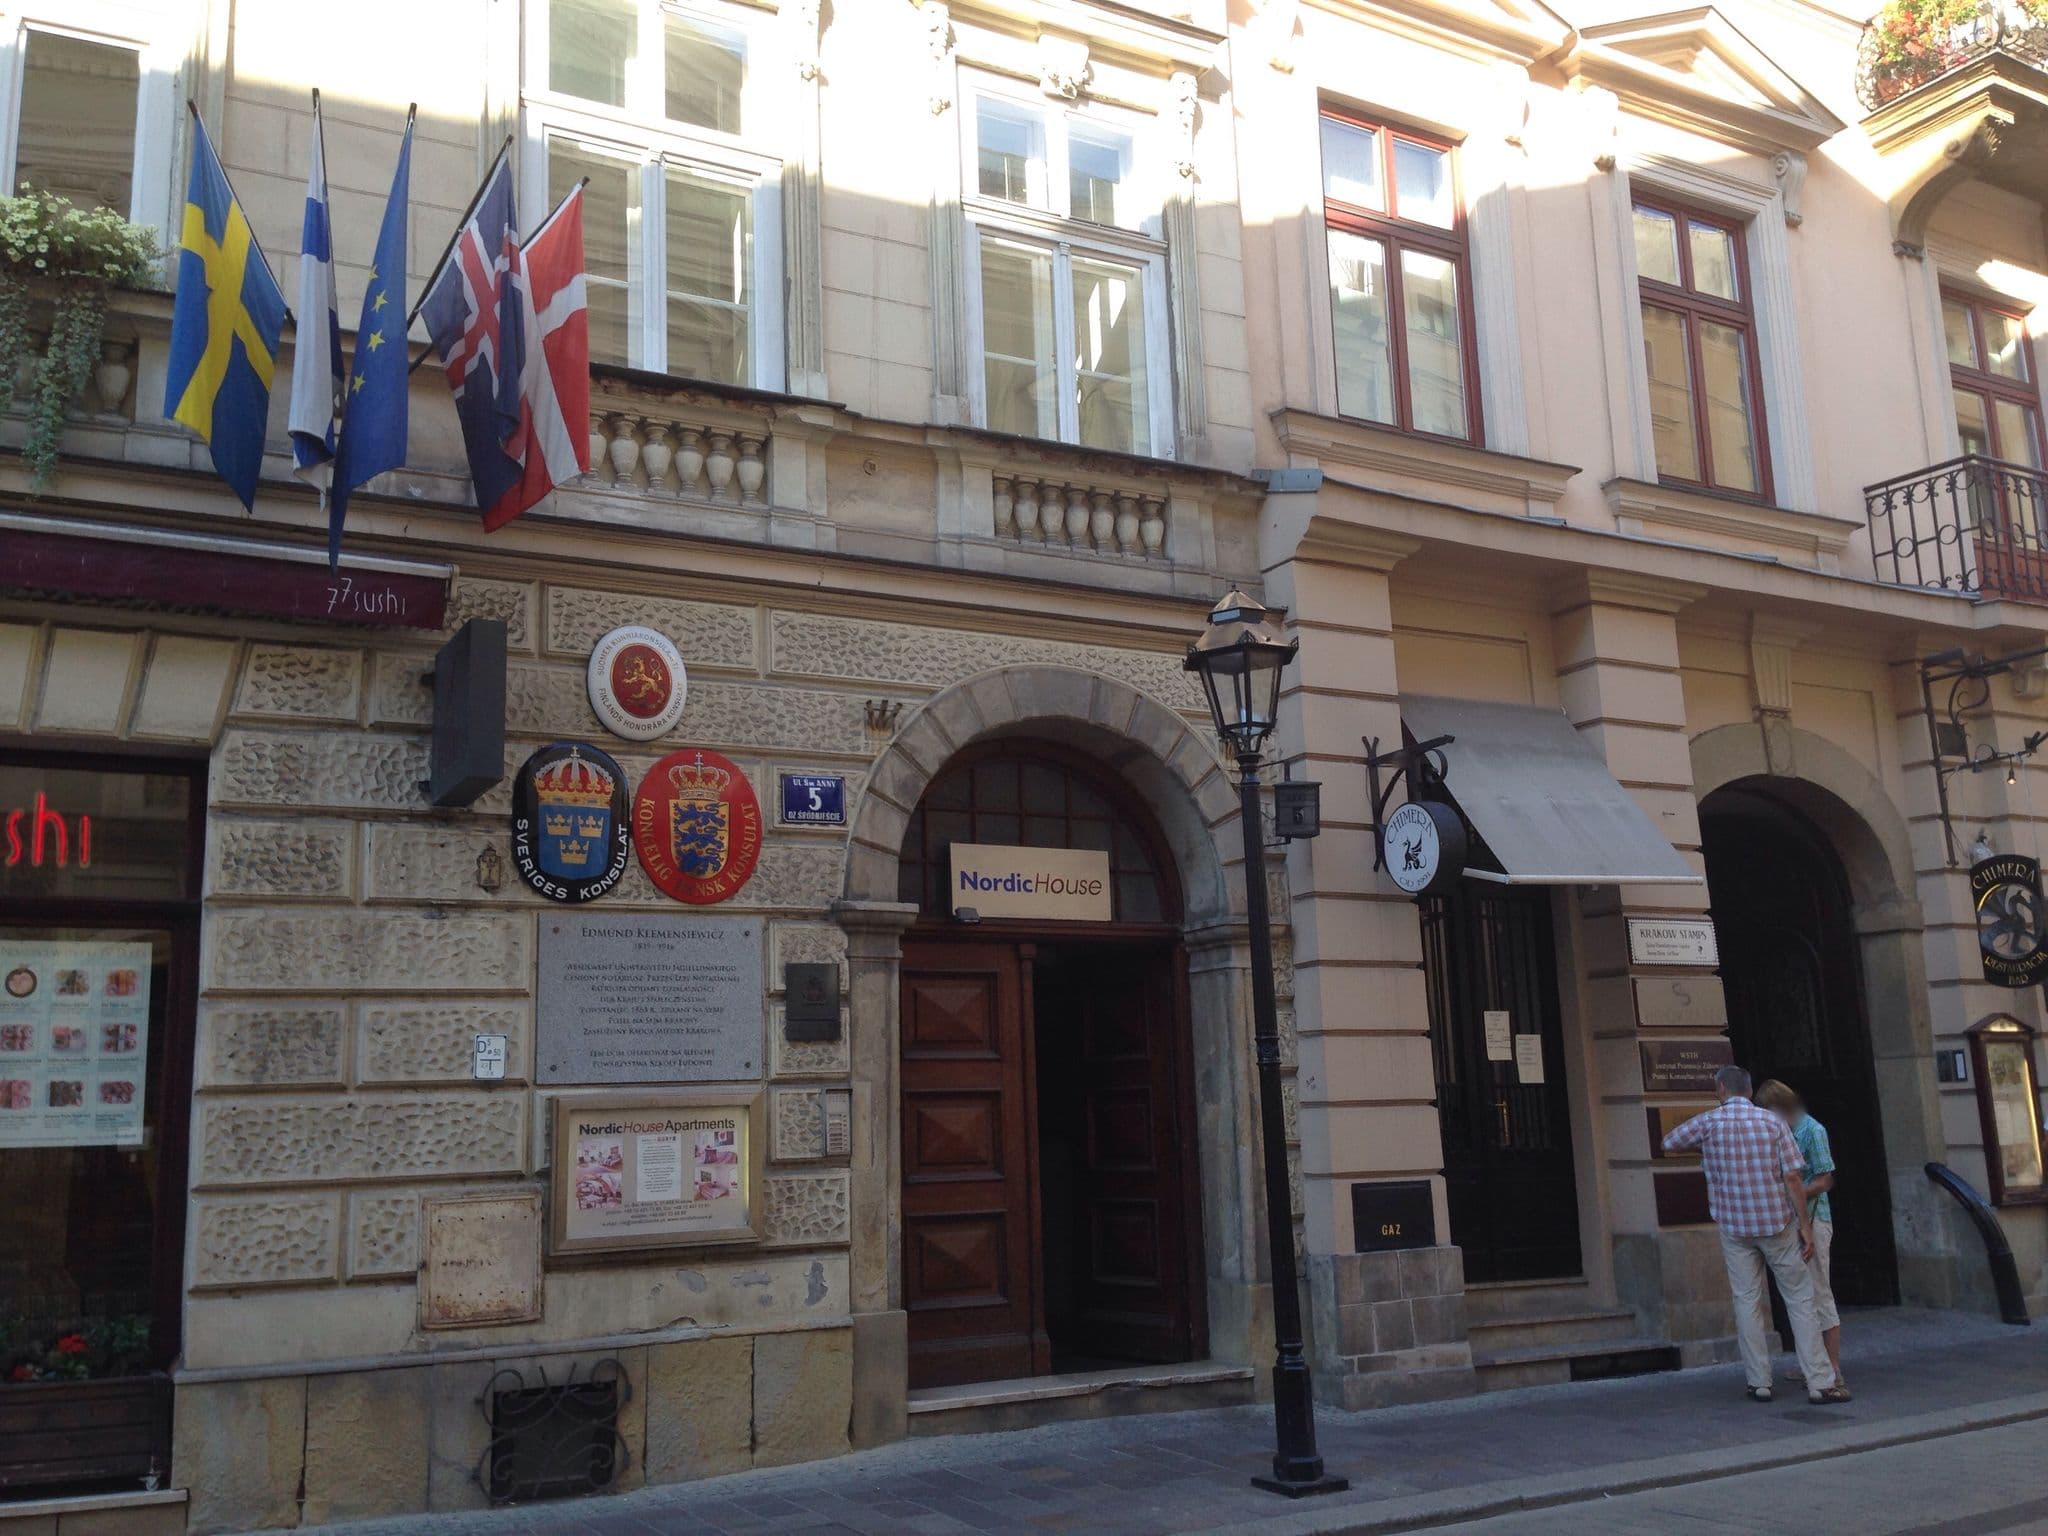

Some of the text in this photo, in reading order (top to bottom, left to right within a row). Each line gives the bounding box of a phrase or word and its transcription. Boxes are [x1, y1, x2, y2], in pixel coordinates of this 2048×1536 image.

[600, 688, 623, 722] FINLANDS
[816, 778, 836, 788] ANNY
[808, 787, 822, 811] 5
[1387, 808, 1432, 844] CHIMERA
[639, 798, 673, 881] KONGELIG
[726, 802, 757, 884] KONSULAT
[517, 818, 628, 900] SVERIGES KONSULAT
[1972, 862, 2035, 890] CHIMERA
[581, 927, 725, 940] EDMUND KLEMENSIEWICZ
[1679, 929, 1707, 941] STAMPS
[1381, 1224, 1401, 1236] GAZ
